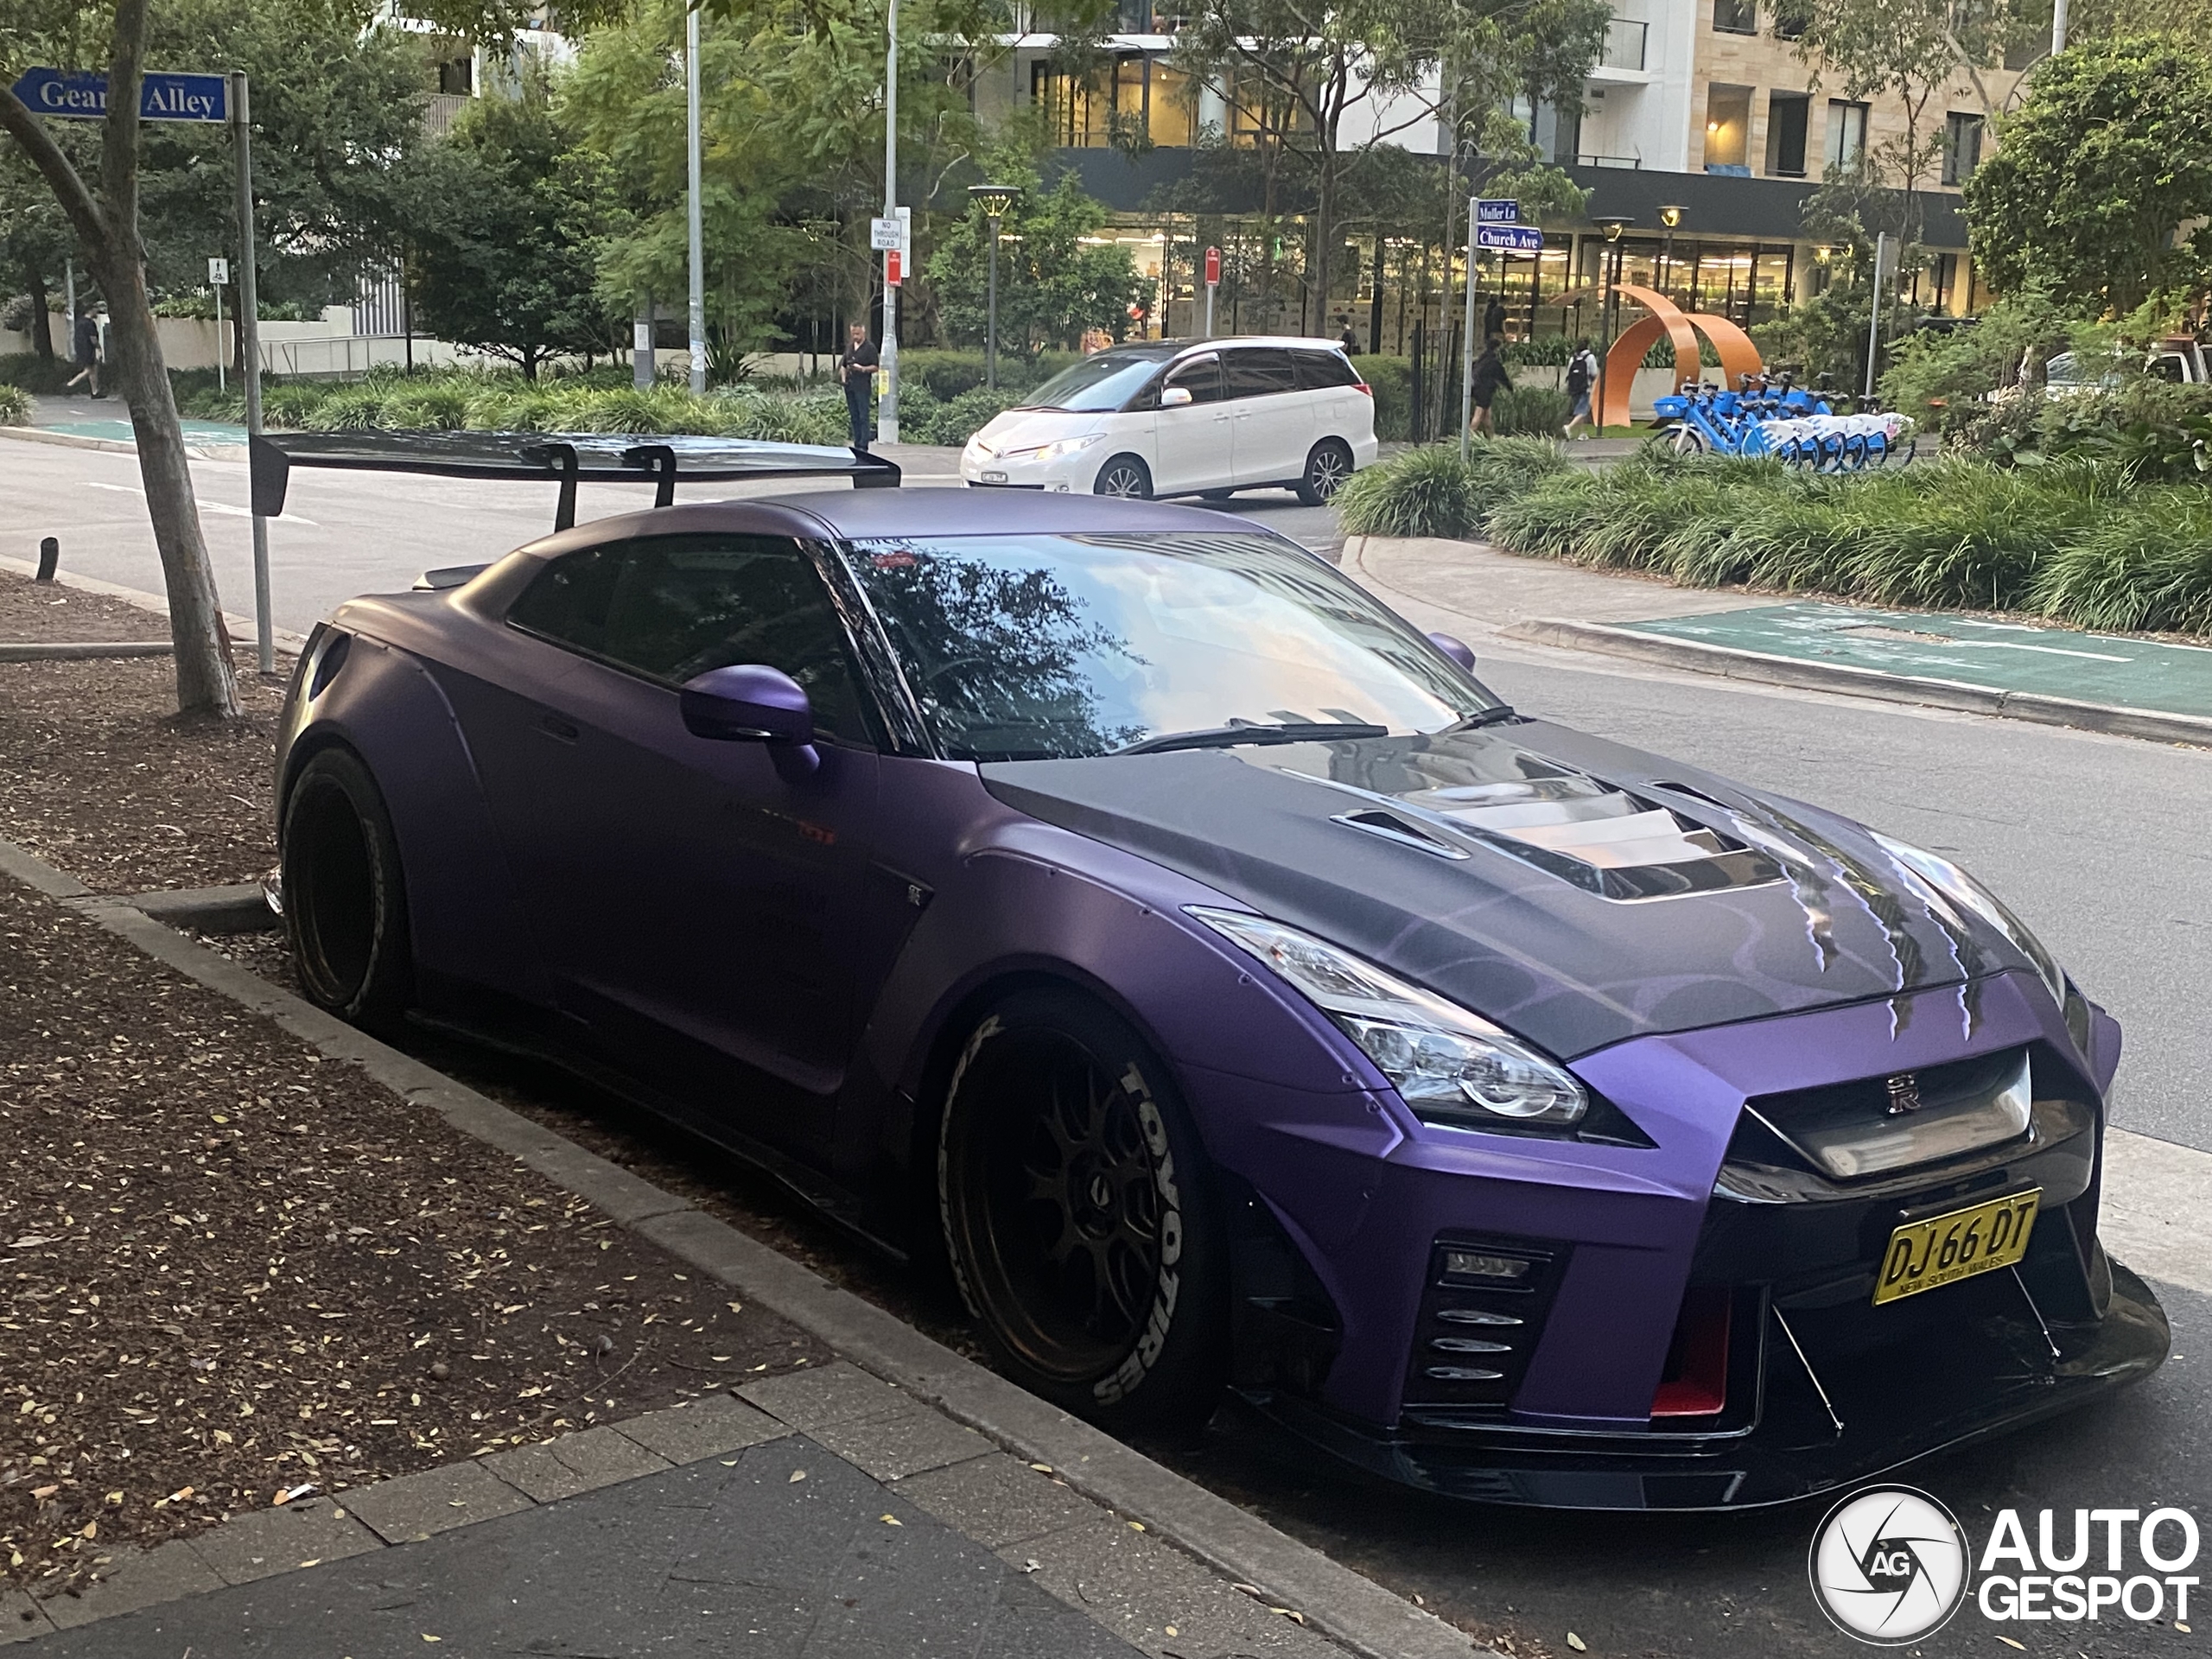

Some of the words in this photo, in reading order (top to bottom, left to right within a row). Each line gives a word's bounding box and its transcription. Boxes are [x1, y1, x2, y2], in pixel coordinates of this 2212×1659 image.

[147, 87, 215, 120] Alley
[1505, 207, 1516, 219] Ln
[874, 230, 899, 238] THROUGH
[1479, 231, 1516, 246] Church
[1519, 235, 1538, 249] Ave
